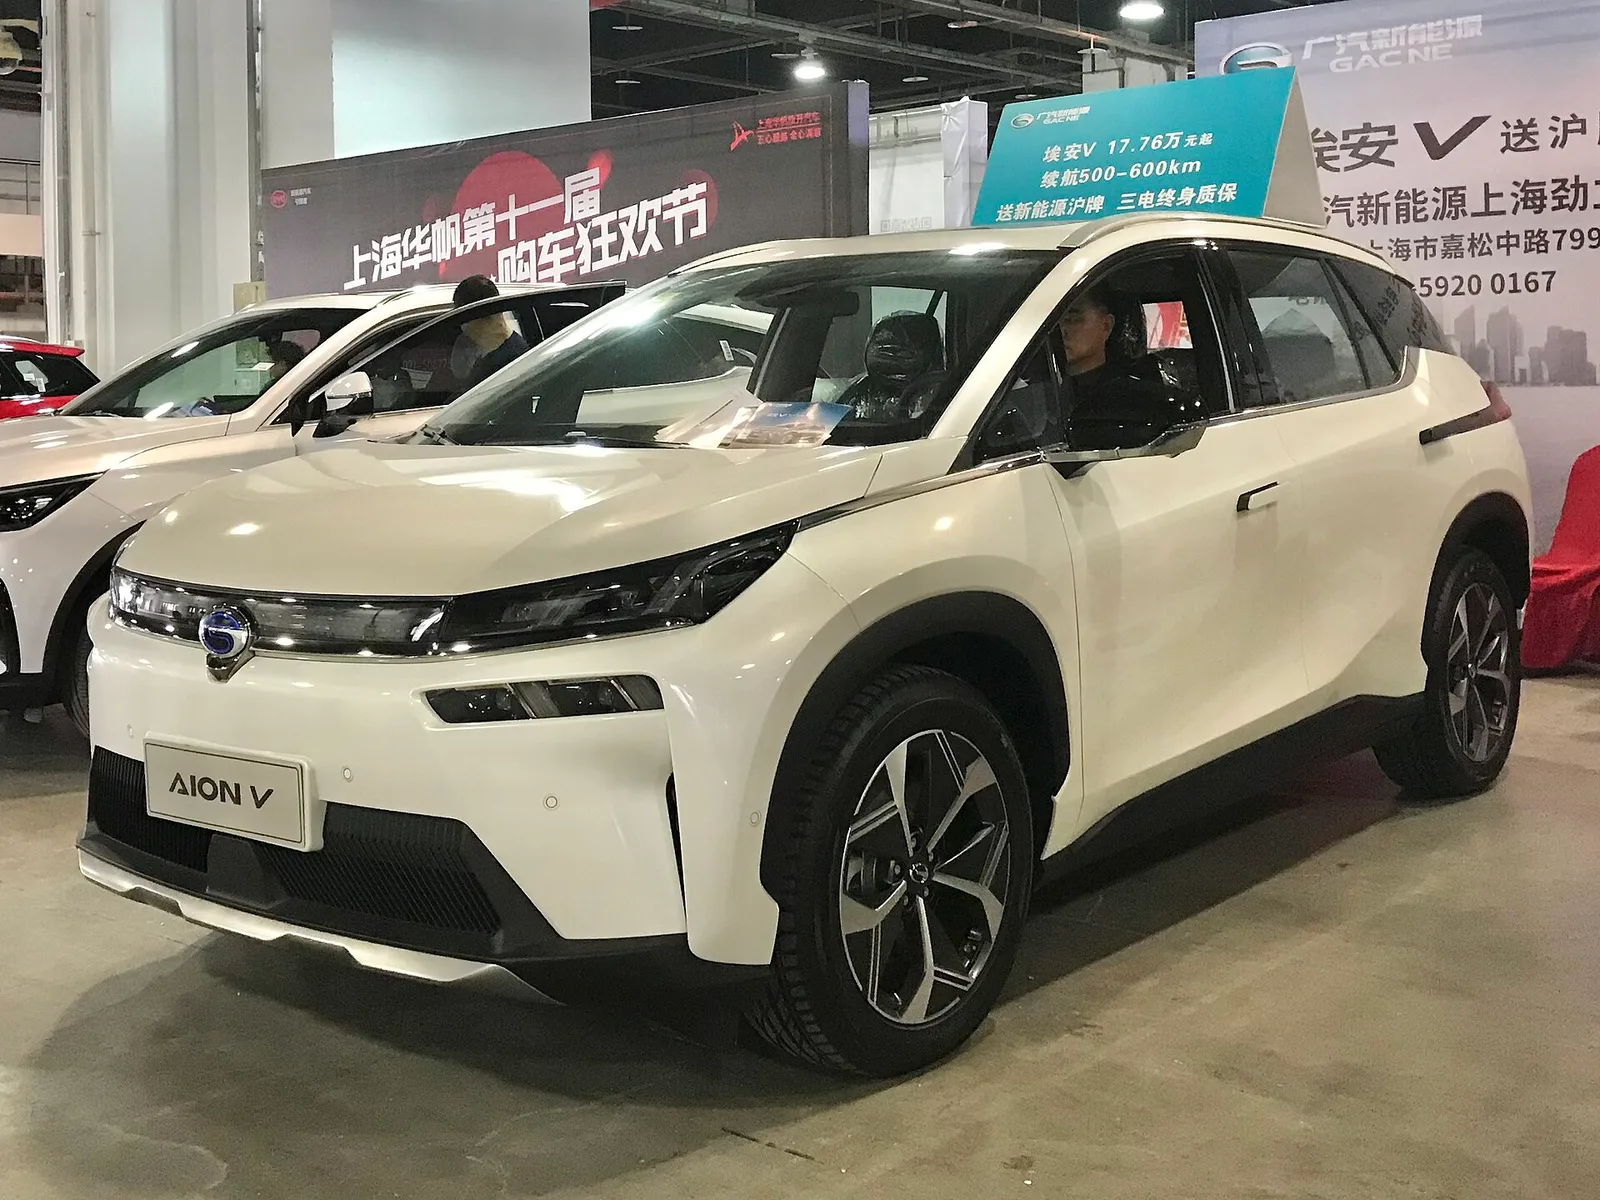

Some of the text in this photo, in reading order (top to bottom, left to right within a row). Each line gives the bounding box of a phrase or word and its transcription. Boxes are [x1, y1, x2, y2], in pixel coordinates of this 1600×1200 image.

[1302, 14, 1483, 61] 广汽新能源
[1413, 115, 1492, 161] V
[995, 182, 1237, 222] 送新能源沪牌 三电终身质保
[1323, 174, 1600, 229] 汽新能源上海劲
[343, 166, 600, 290] 上海华帆第十一届
[497, 182, 707, 284] 购车狂欢节
[1489, 270, 1557, 295] 0167
[169, 772, 274, 809] AION V
